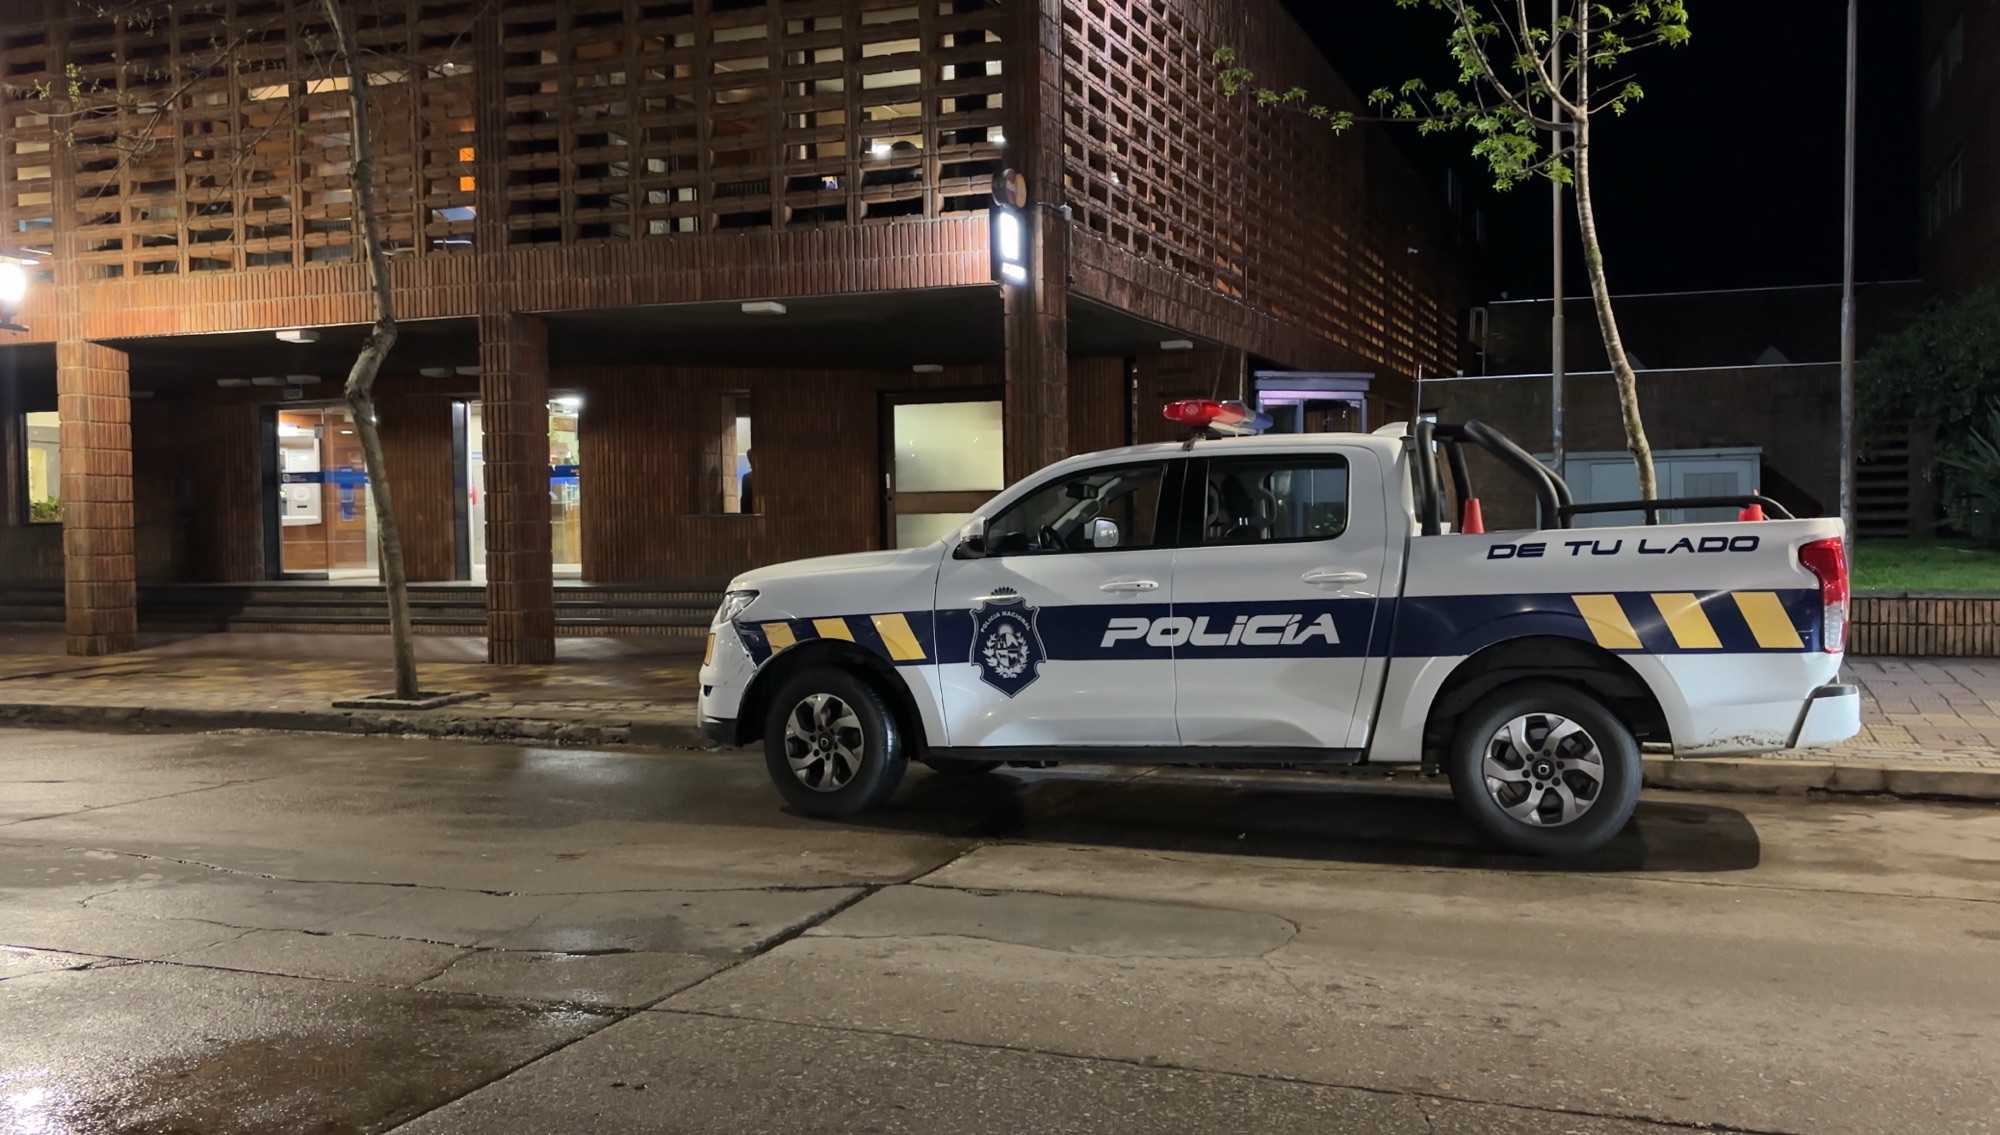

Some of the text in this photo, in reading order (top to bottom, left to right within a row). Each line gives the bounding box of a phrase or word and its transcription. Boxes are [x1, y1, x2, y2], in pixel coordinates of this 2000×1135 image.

[1486, 535, 1760, 560] DE TU LADO
[1001, 610, 1031, 631] NACIONAL
